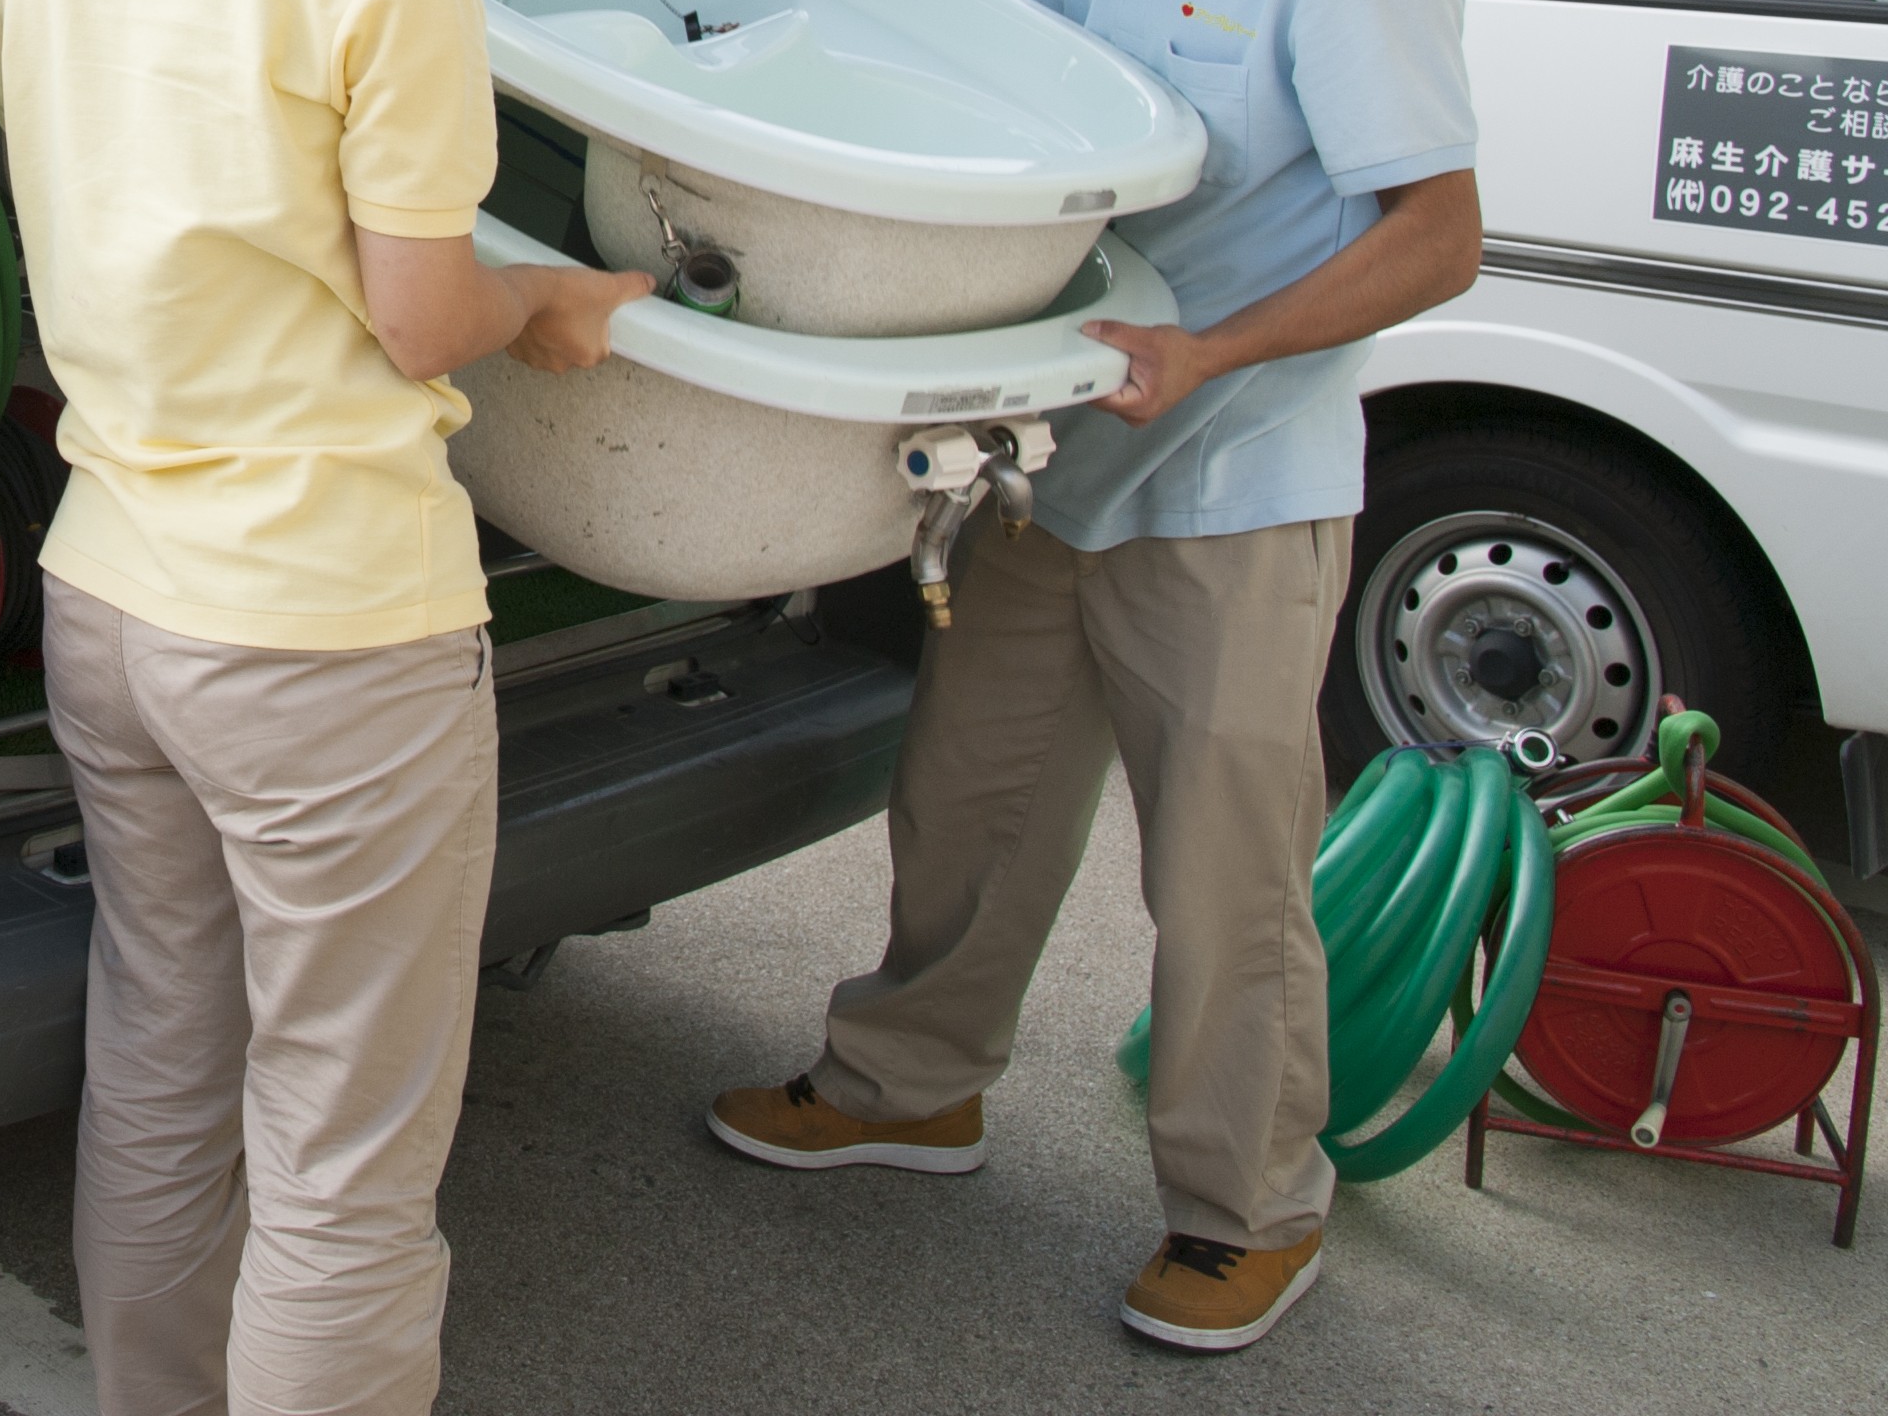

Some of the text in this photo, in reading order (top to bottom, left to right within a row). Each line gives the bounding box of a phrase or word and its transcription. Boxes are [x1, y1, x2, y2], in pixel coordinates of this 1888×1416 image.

[1668, 136, 1888, 184] 麻生介護サ
